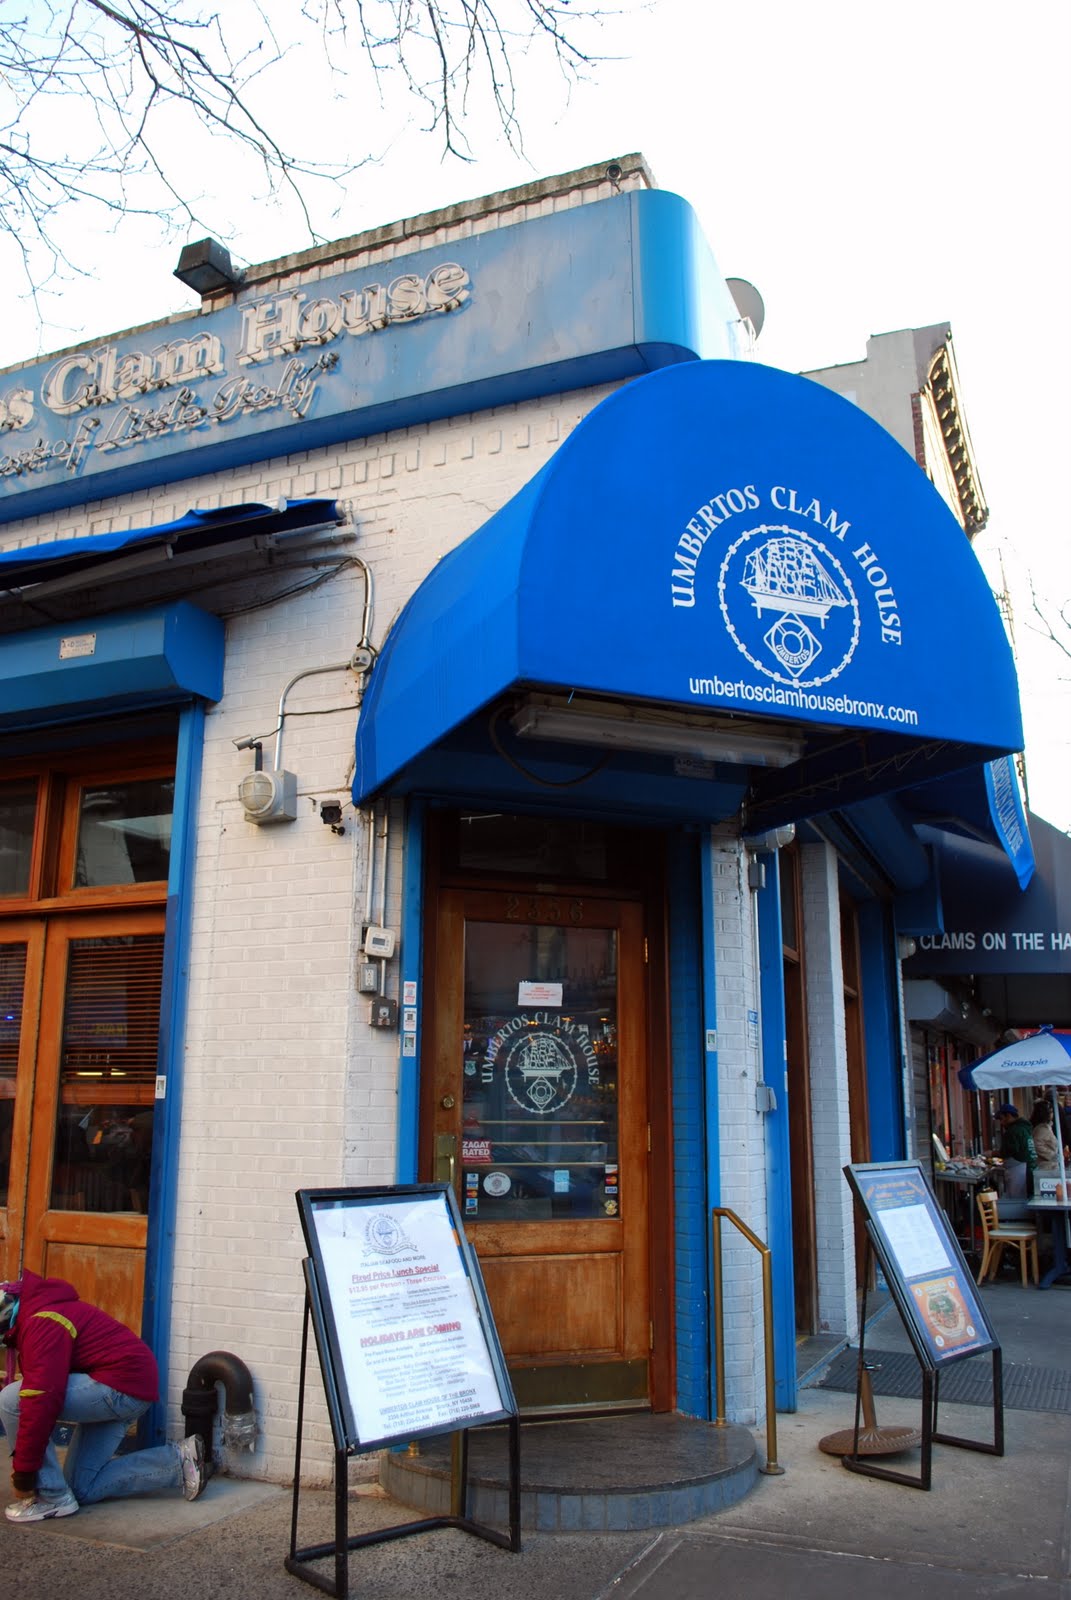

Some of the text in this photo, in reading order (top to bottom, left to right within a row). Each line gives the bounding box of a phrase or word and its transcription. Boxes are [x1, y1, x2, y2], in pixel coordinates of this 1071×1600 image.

[41, 331, 224, 416] Clam
[236, 261, 471, 366] House
[95, 386, 207, 452] Little
[671, 484, 902, 646] UMBERTOS CLAM HOUSE
[775, 644, 810, 665] UMBERTOS
[688, 675, 919, 726] umbertosclamhousebronx.com
[920, 932, 976, 950] CLAMS
[982, 932, 1007, 950] ON
[1012, 932, 1045, 950] THE
[482, 1011, 600, 1085] UMBERTOS CLAM HOUSE
[1001, 1059, 1049, 1068] Snapple
[462, 1141, 491, 1149] ZAGAT
[462, 1148, 491, 1156] RATED
[352, 1263, 439, 1283] Fixed Price Lunch Special
[381, 1280, 401, 1289] Person
[406, 1277, 422, 1285] Three
[423, 1274, 446, 1282] Courses
[360, 1331, 405, 1347] HOLIDAYS
[407, 1327, 425, 1338] ARE
[427, 1321, 461, 1333] COMING
[459, 1388, 476, 1396] BRONX
